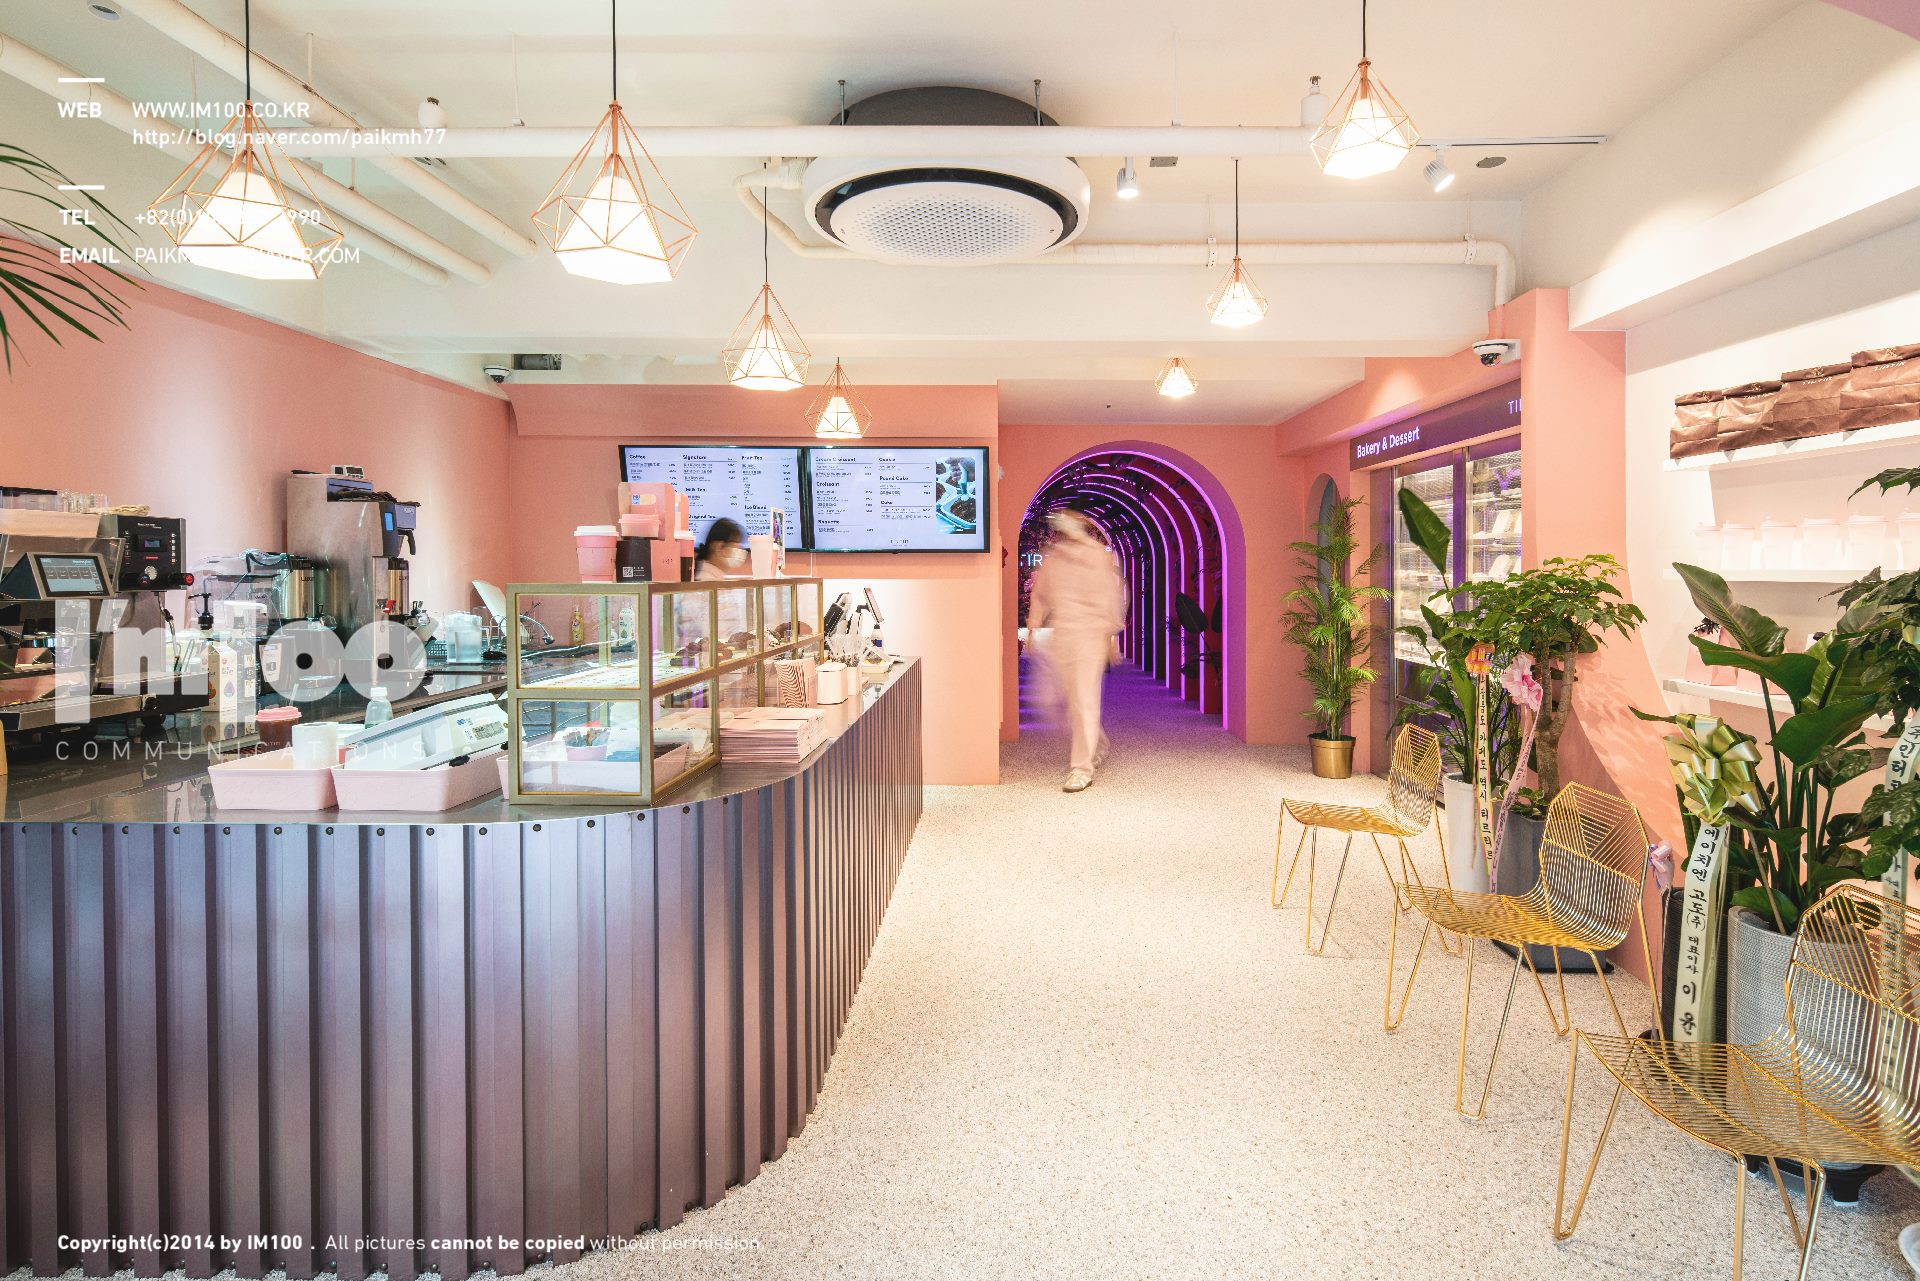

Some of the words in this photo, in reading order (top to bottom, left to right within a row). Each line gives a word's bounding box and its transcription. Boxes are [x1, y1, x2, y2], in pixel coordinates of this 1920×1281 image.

[1357, 441, 1381, 459] Bakery
[1382, 436, 1388, 451] &
[1389, 425, 1420, 449] Dessert
[1480, 807, 1493, 860] 티르티르
